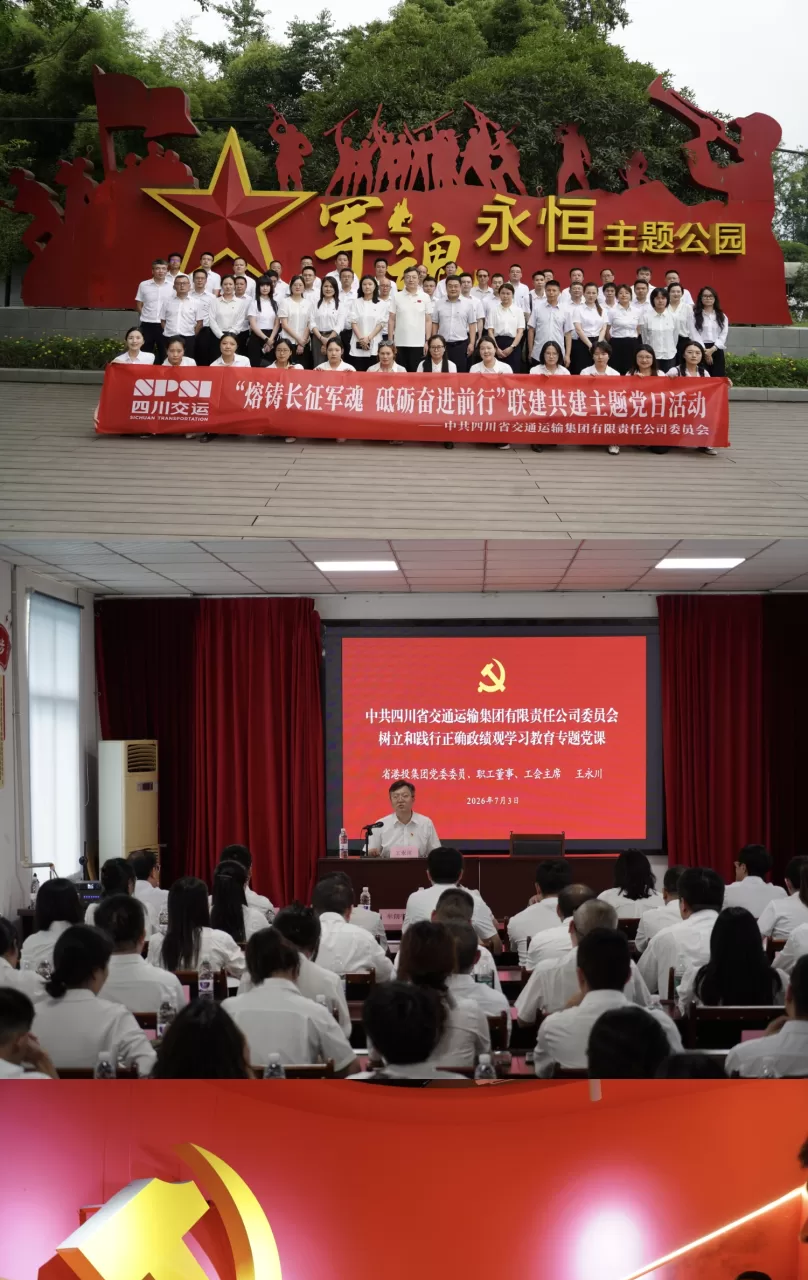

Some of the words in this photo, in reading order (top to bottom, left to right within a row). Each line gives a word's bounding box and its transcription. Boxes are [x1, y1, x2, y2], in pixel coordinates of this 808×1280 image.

[132, 378, 213, 398] SPSI
[131, 400, 209, 416] 四川交运
[365, 707, 619, 724] 中共四川省交通运输集团有限责任公司委员会
[378, 730, 606, 746] 树立和践行正确政绩观学习教育专题党课
[575, 768, 603, 779] 王永川
[466, 796, 519, 805] 2026年7月3日
